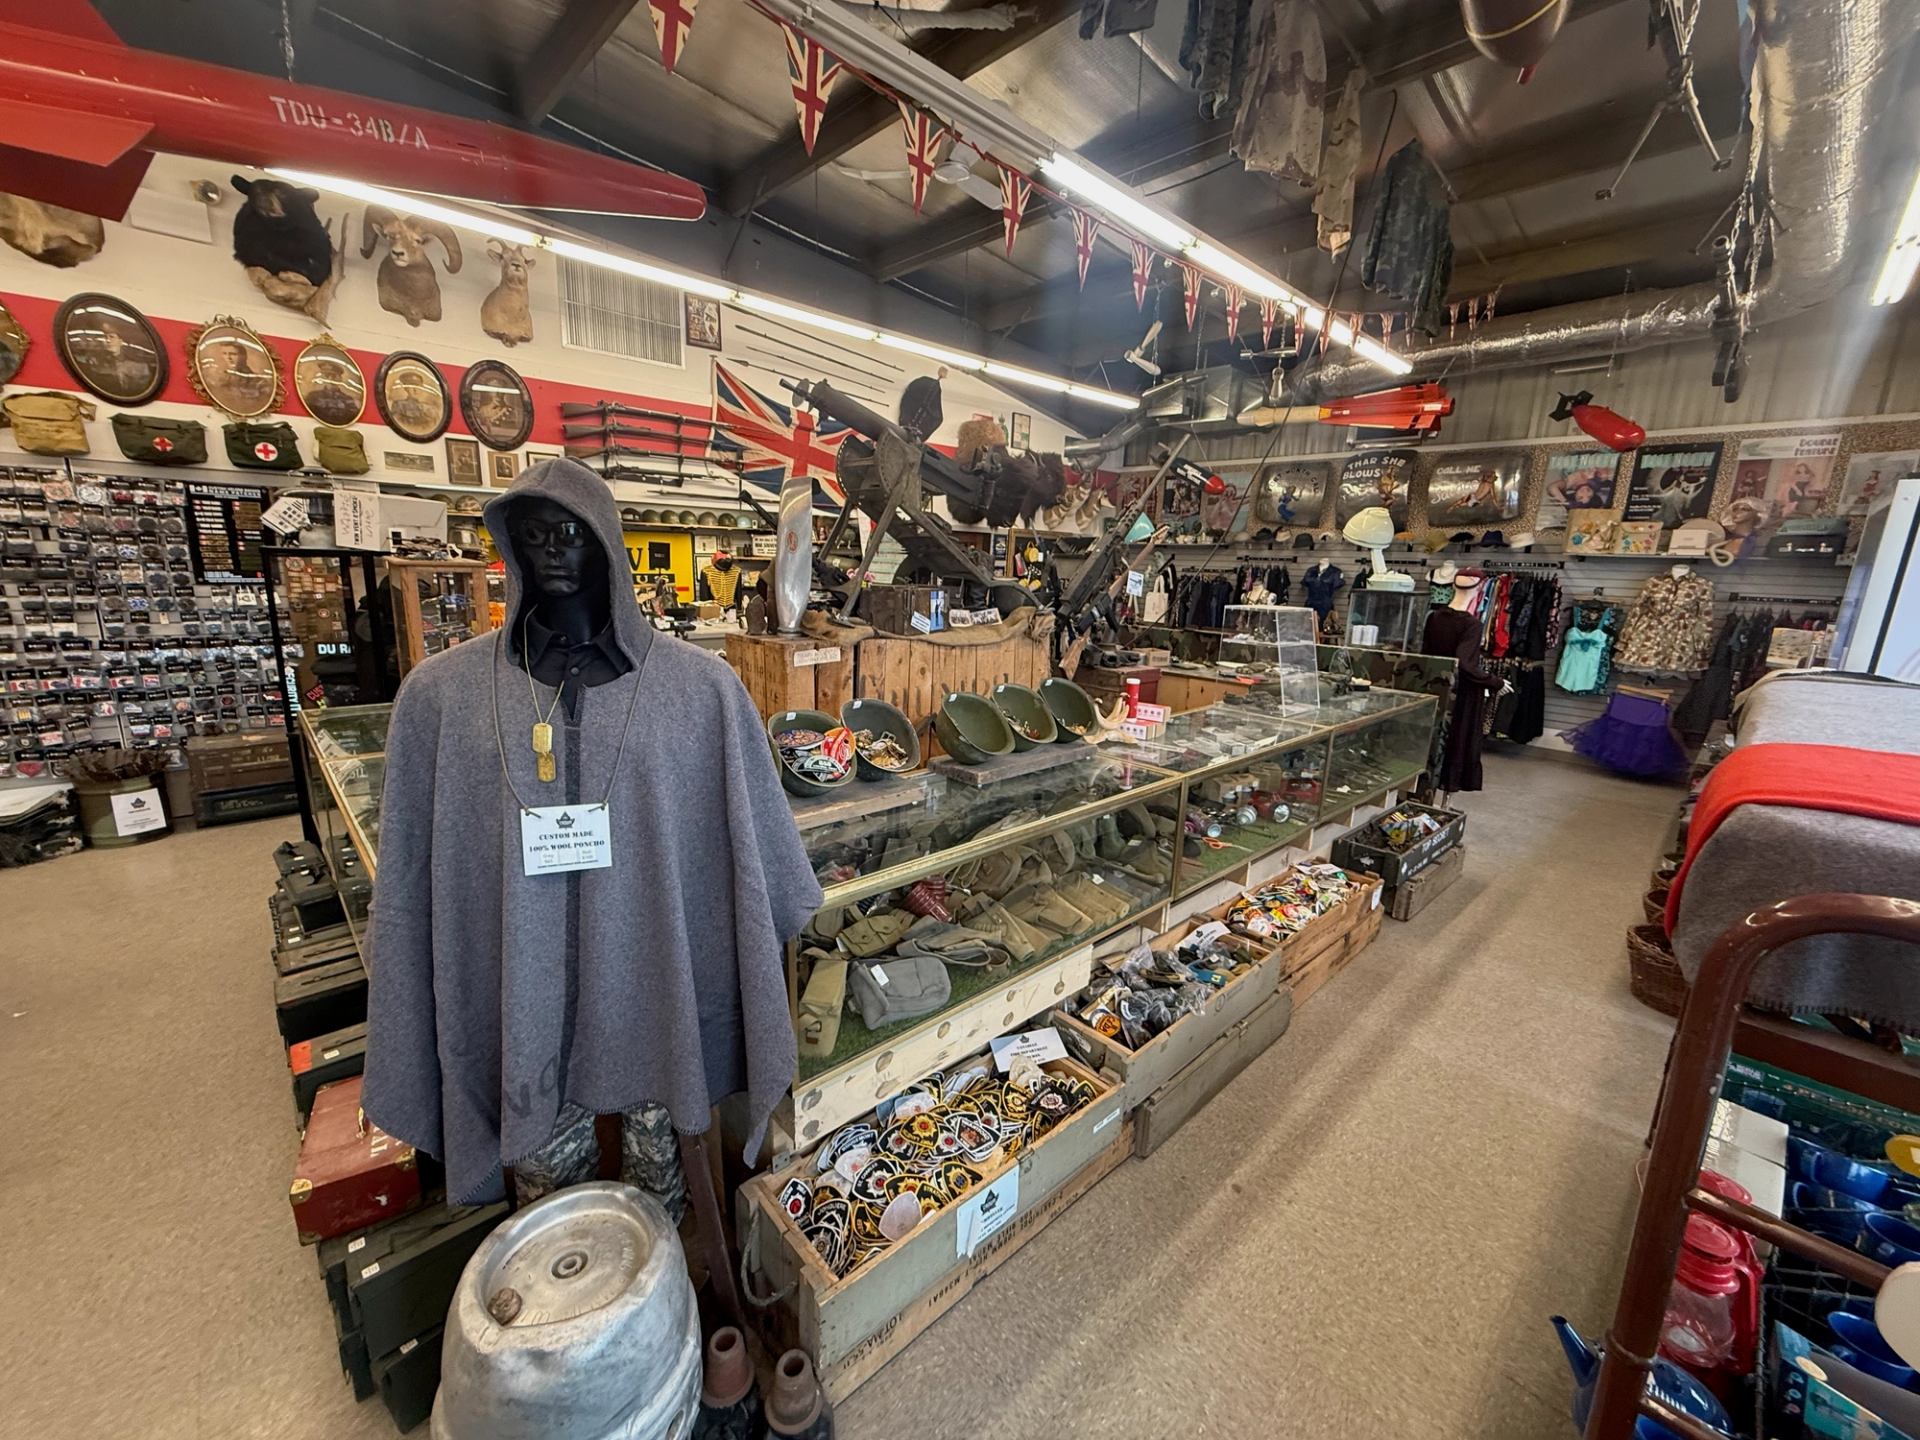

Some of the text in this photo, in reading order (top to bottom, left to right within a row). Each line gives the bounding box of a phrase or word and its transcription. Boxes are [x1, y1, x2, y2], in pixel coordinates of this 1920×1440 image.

[269, 95, 430, 150] TDU-34B/A
[1347, 456, 1407, 471] THAR SHE
[1342, 469, 1382, 481] BLOWS
[538, 830, 594, 841] CUSTOM MADE
[550, 842, 573, 851] WOOL
[573, 839, 605, 849] PONCHO
